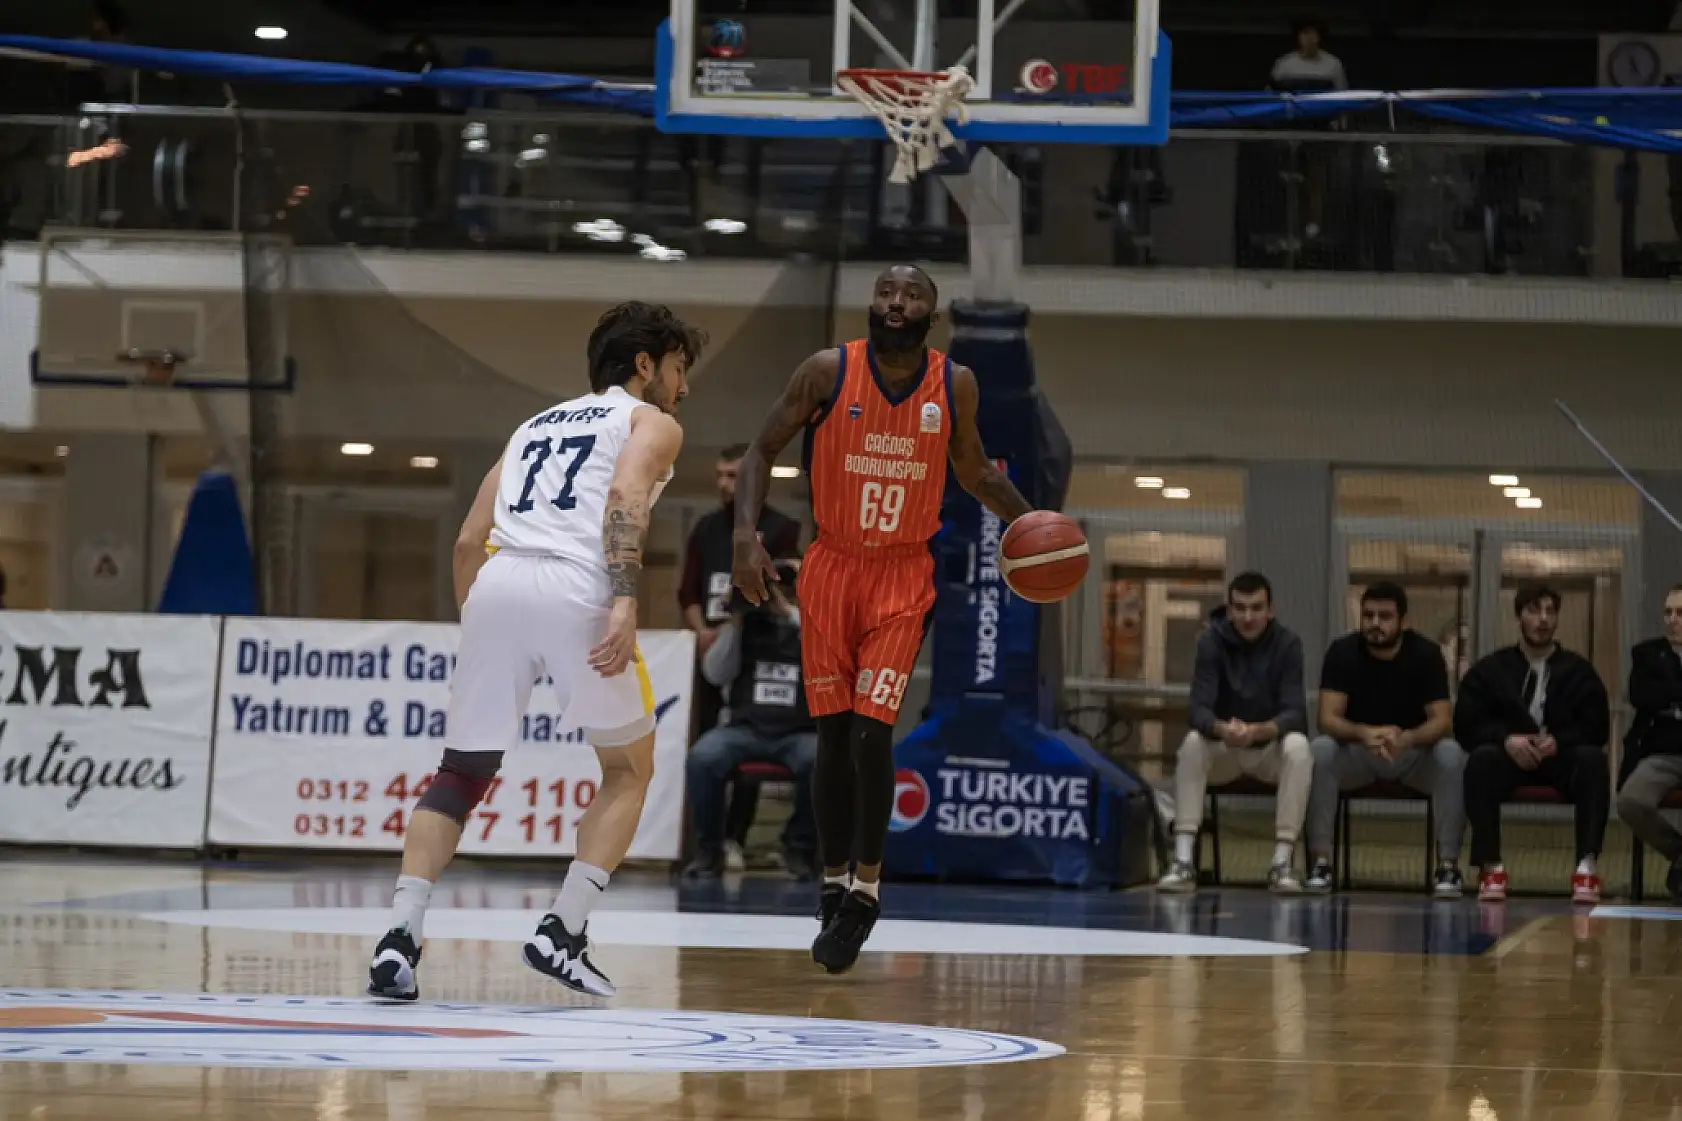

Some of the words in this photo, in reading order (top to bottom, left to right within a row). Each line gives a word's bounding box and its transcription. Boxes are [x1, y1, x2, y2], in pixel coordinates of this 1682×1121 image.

[1062, 64, 1128, 93] TBF
[509, 434, 597, 513] 77
[844, 453, 928, 481] BODRUMSPOR
[860, 481, 905, 532] 69
[0, 644, 151, 710] MA
[237, 638, 391, 685] Diplomat
[871, 667, 908, 711] 69
[231, 694, 350, 736] Yatırım
[364, 699, 388, 736] &
[0, 719, 186, 811] ntiques
[297, 778, 369, 801] 0312
[522, 778, 597, 808] 110
[294, 814, 367, 837] 0312
[519, 812, 580, 842] 11
